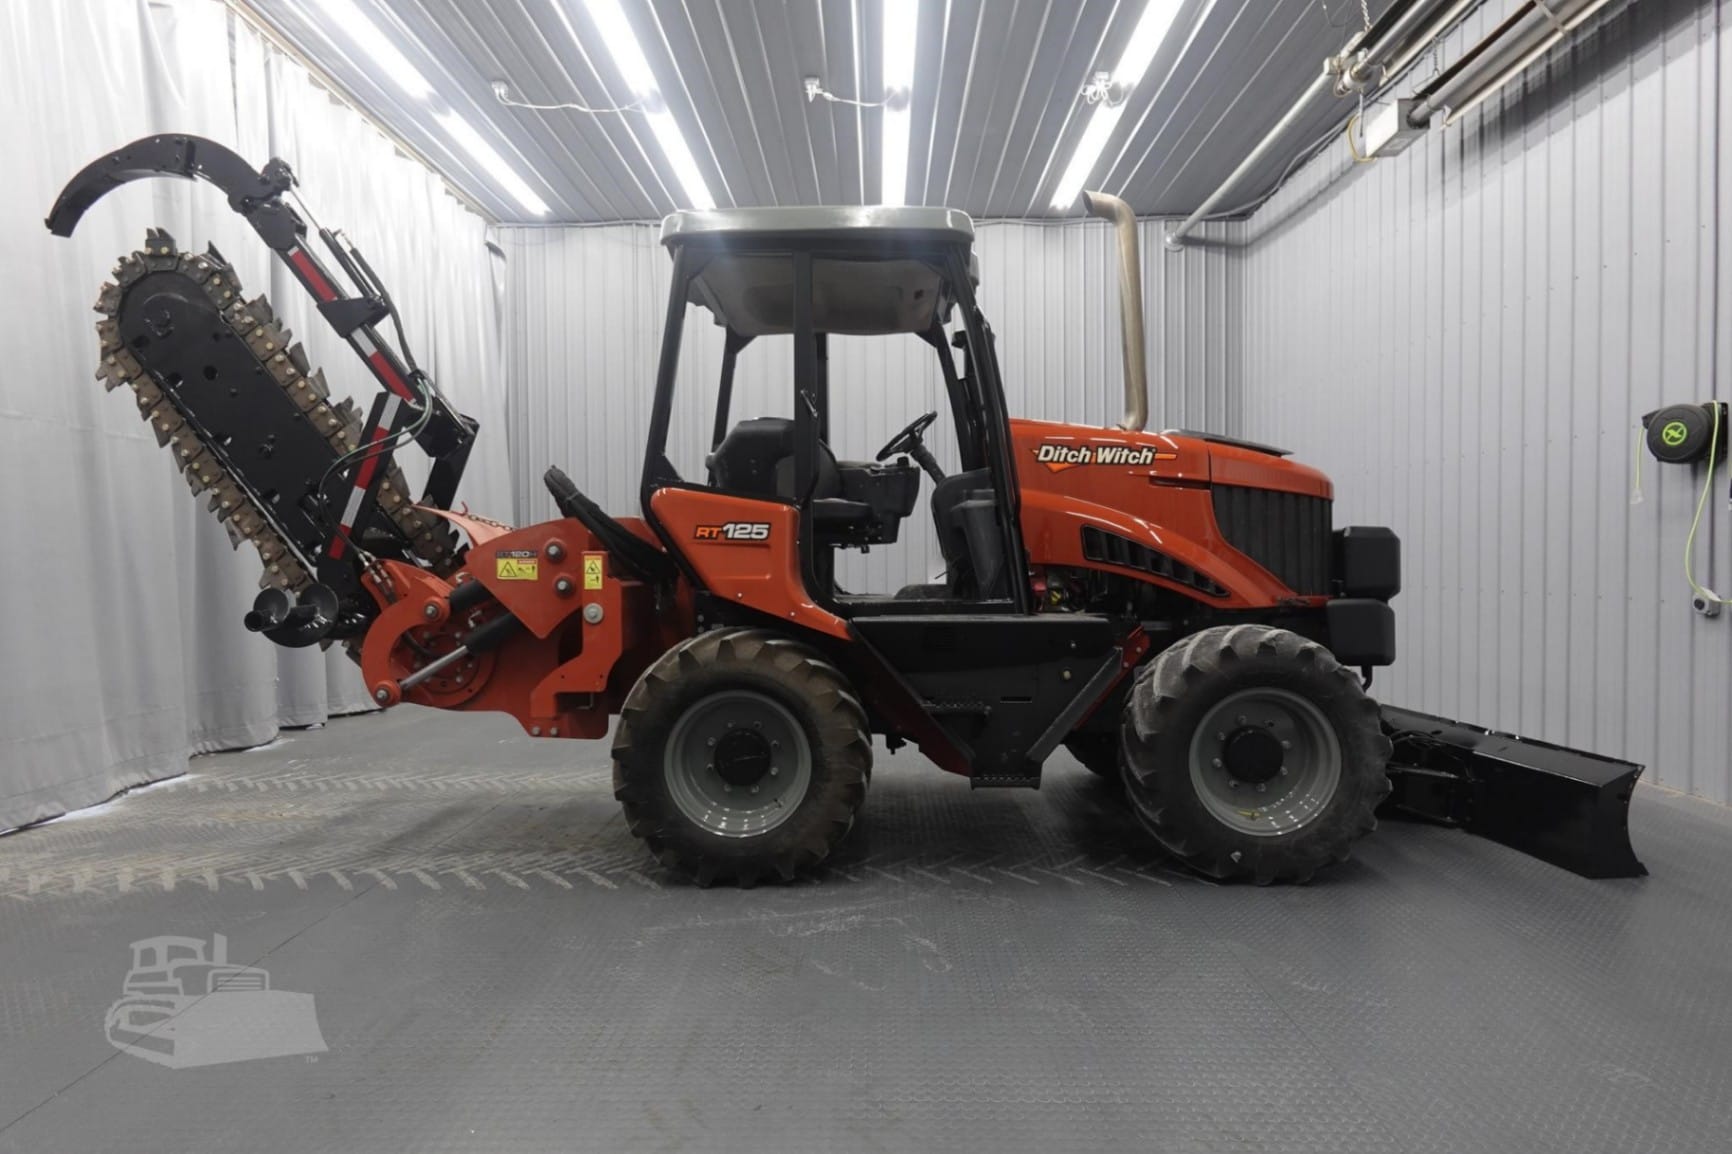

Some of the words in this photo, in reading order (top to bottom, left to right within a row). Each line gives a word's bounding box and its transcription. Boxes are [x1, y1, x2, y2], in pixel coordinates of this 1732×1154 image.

[1038, 445, 1091, 463] Ditch
[1096, 447, 1154, 464] Witch
[695, 523, 770, 540] RT125
